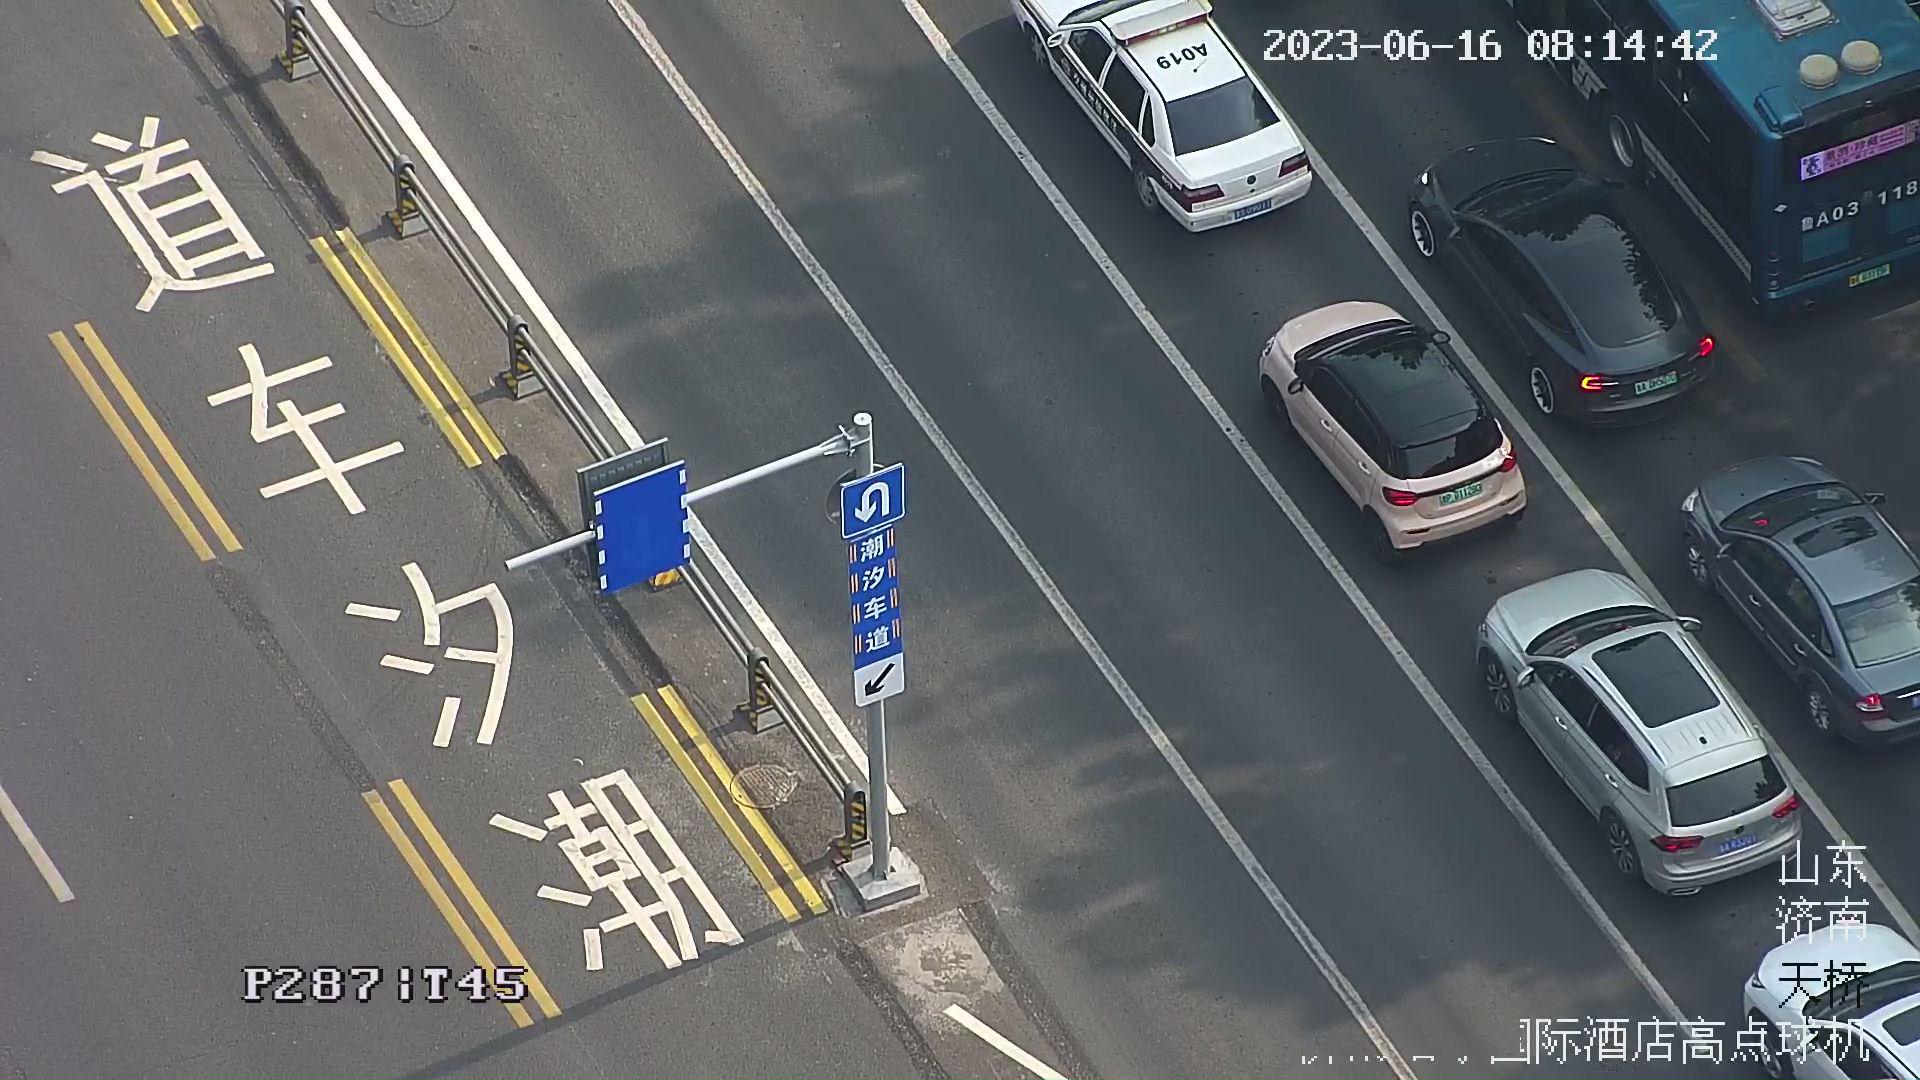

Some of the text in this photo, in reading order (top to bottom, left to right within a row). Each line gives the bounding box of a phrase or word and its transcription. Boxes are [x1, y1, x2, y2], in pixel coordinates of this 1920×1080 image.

[1156, 43, 1207, 69] A019
[860, 536, 890, 653] 潮汐车道
